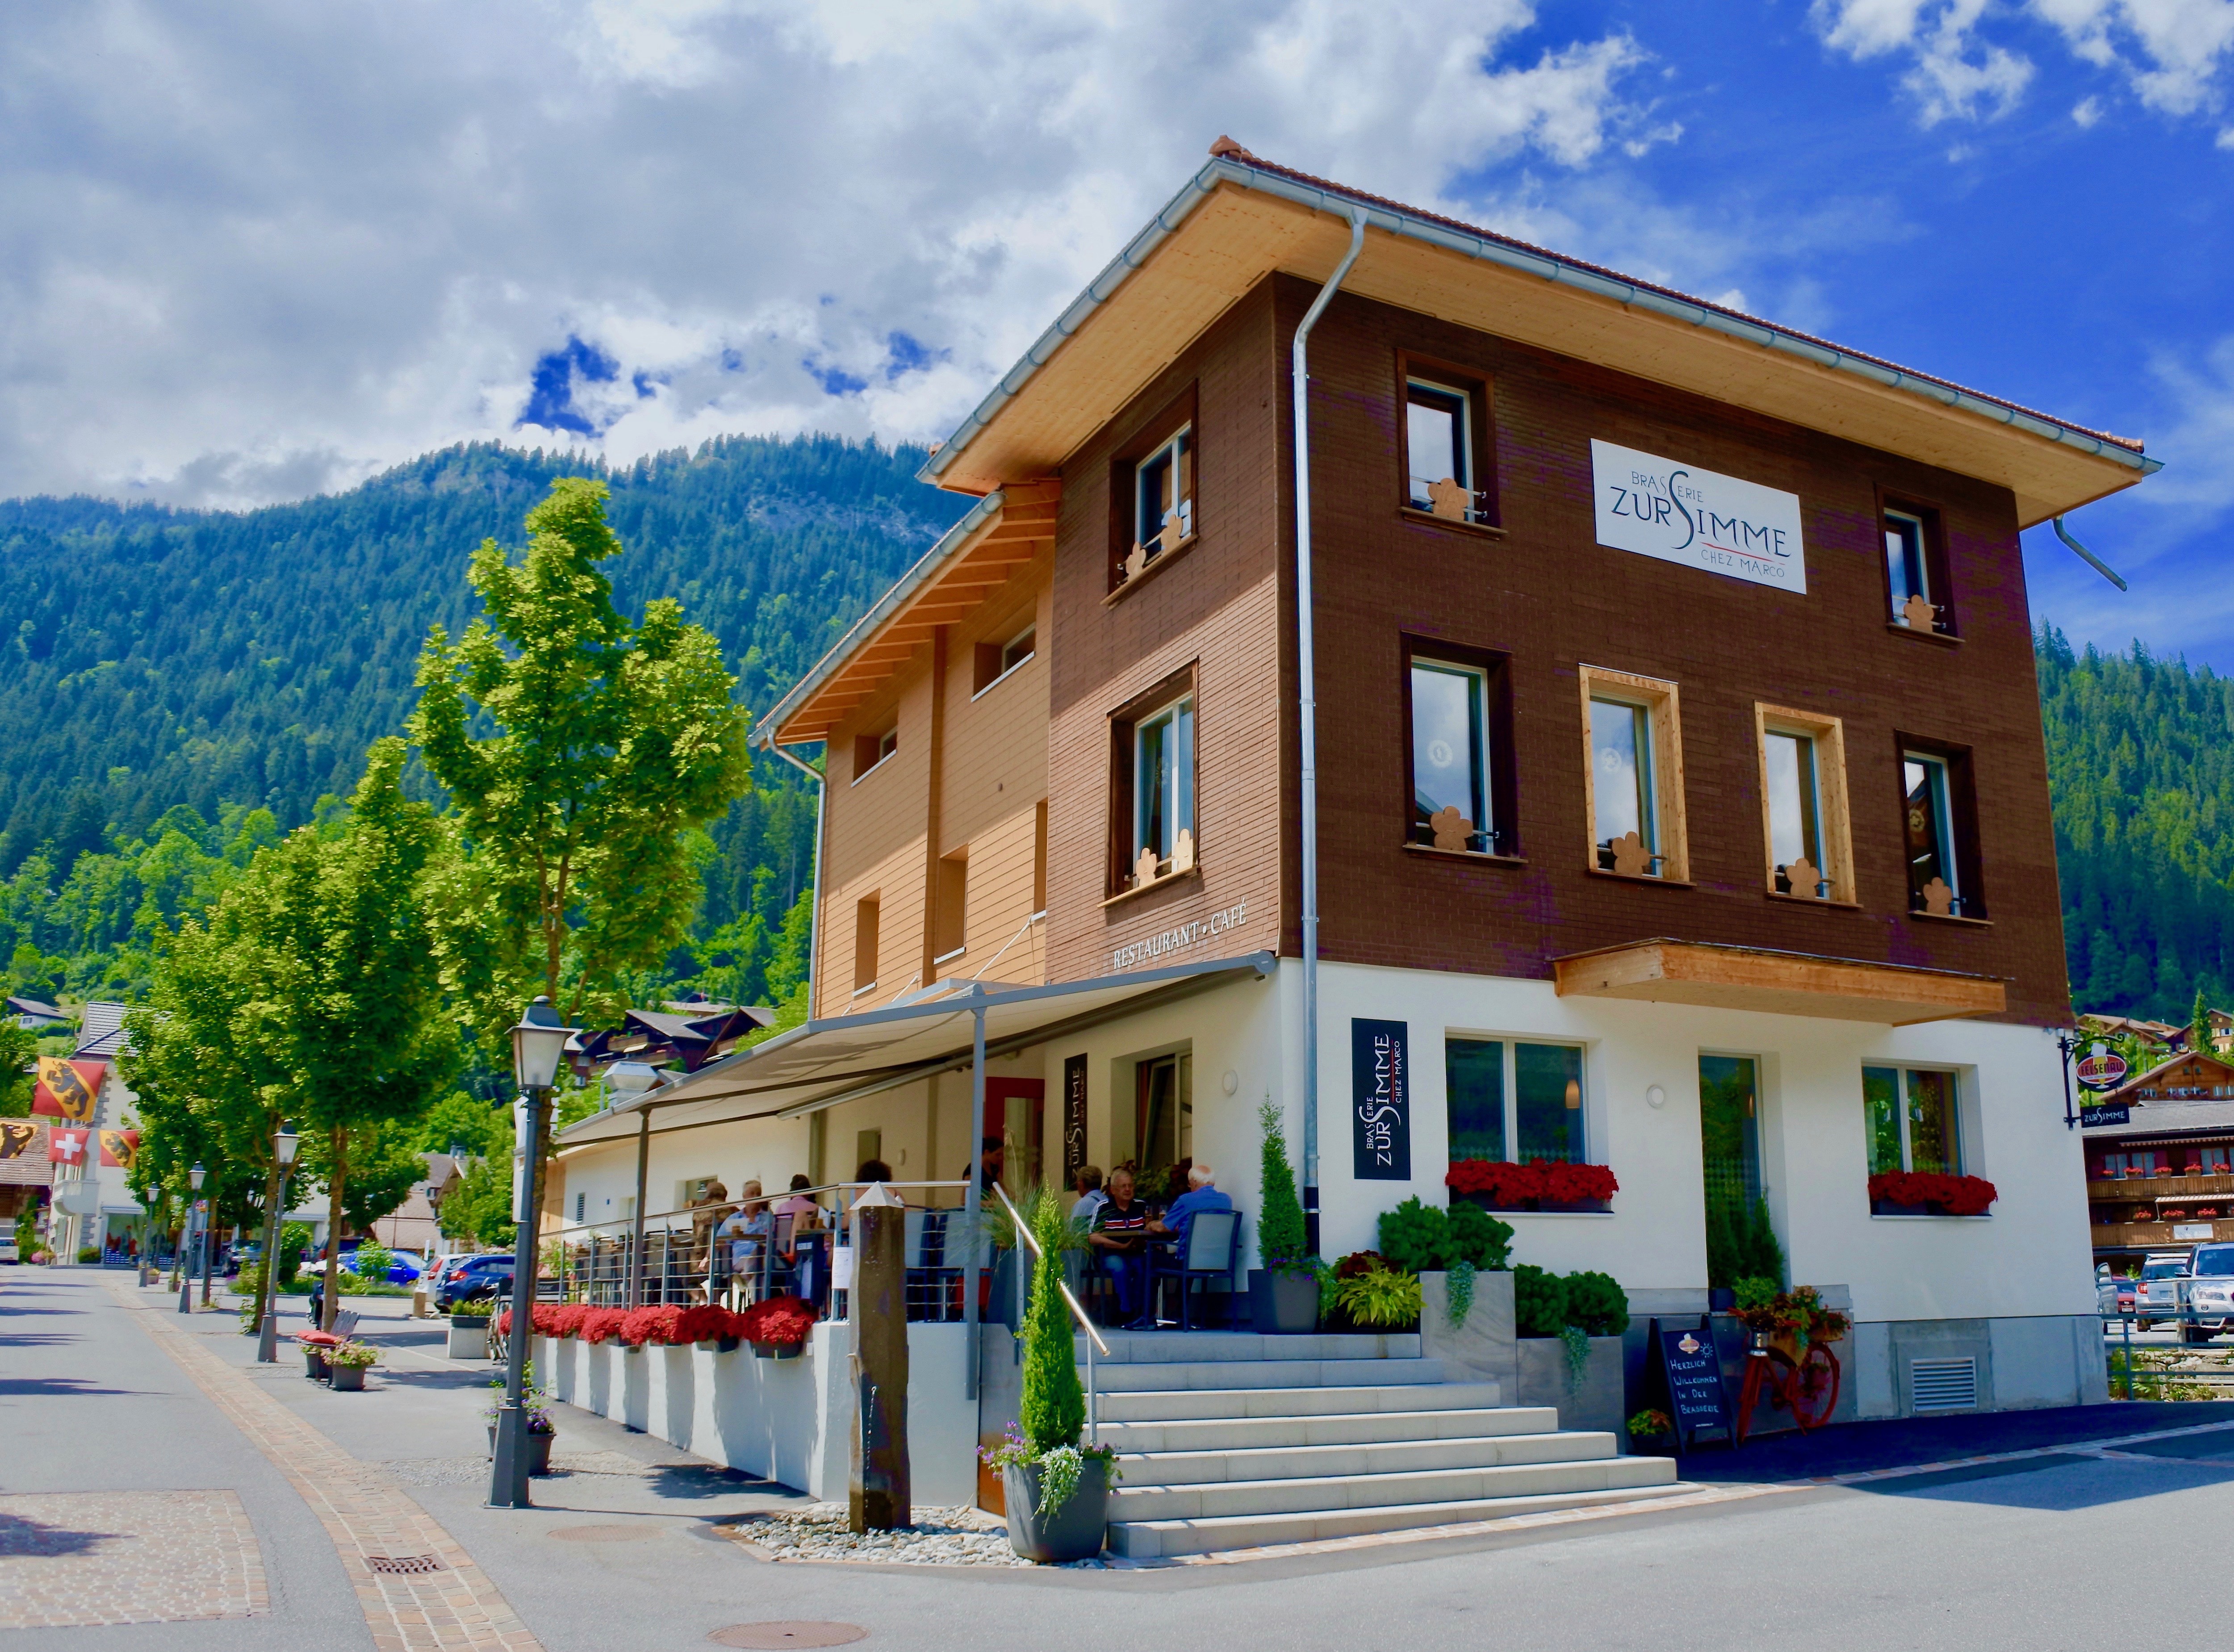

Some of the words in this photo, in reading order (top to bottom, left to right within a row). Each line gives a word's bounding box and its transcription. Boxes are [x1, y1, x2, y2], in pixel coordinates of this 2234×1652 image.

[1701, 549, 1733, 566] CHEZ
[1740, 558, 1785, 577] MARCO
[1113, 921, 1199, 970] RESTAURANT
[1210, 897, 1247, 935] CAFÉ
[1394, 1041, 1402, 1075] MARCO
[2081, 1062, 2122, 1076] FELSENAU
[1670, 1359, 1706, 1370] HERZLICH
